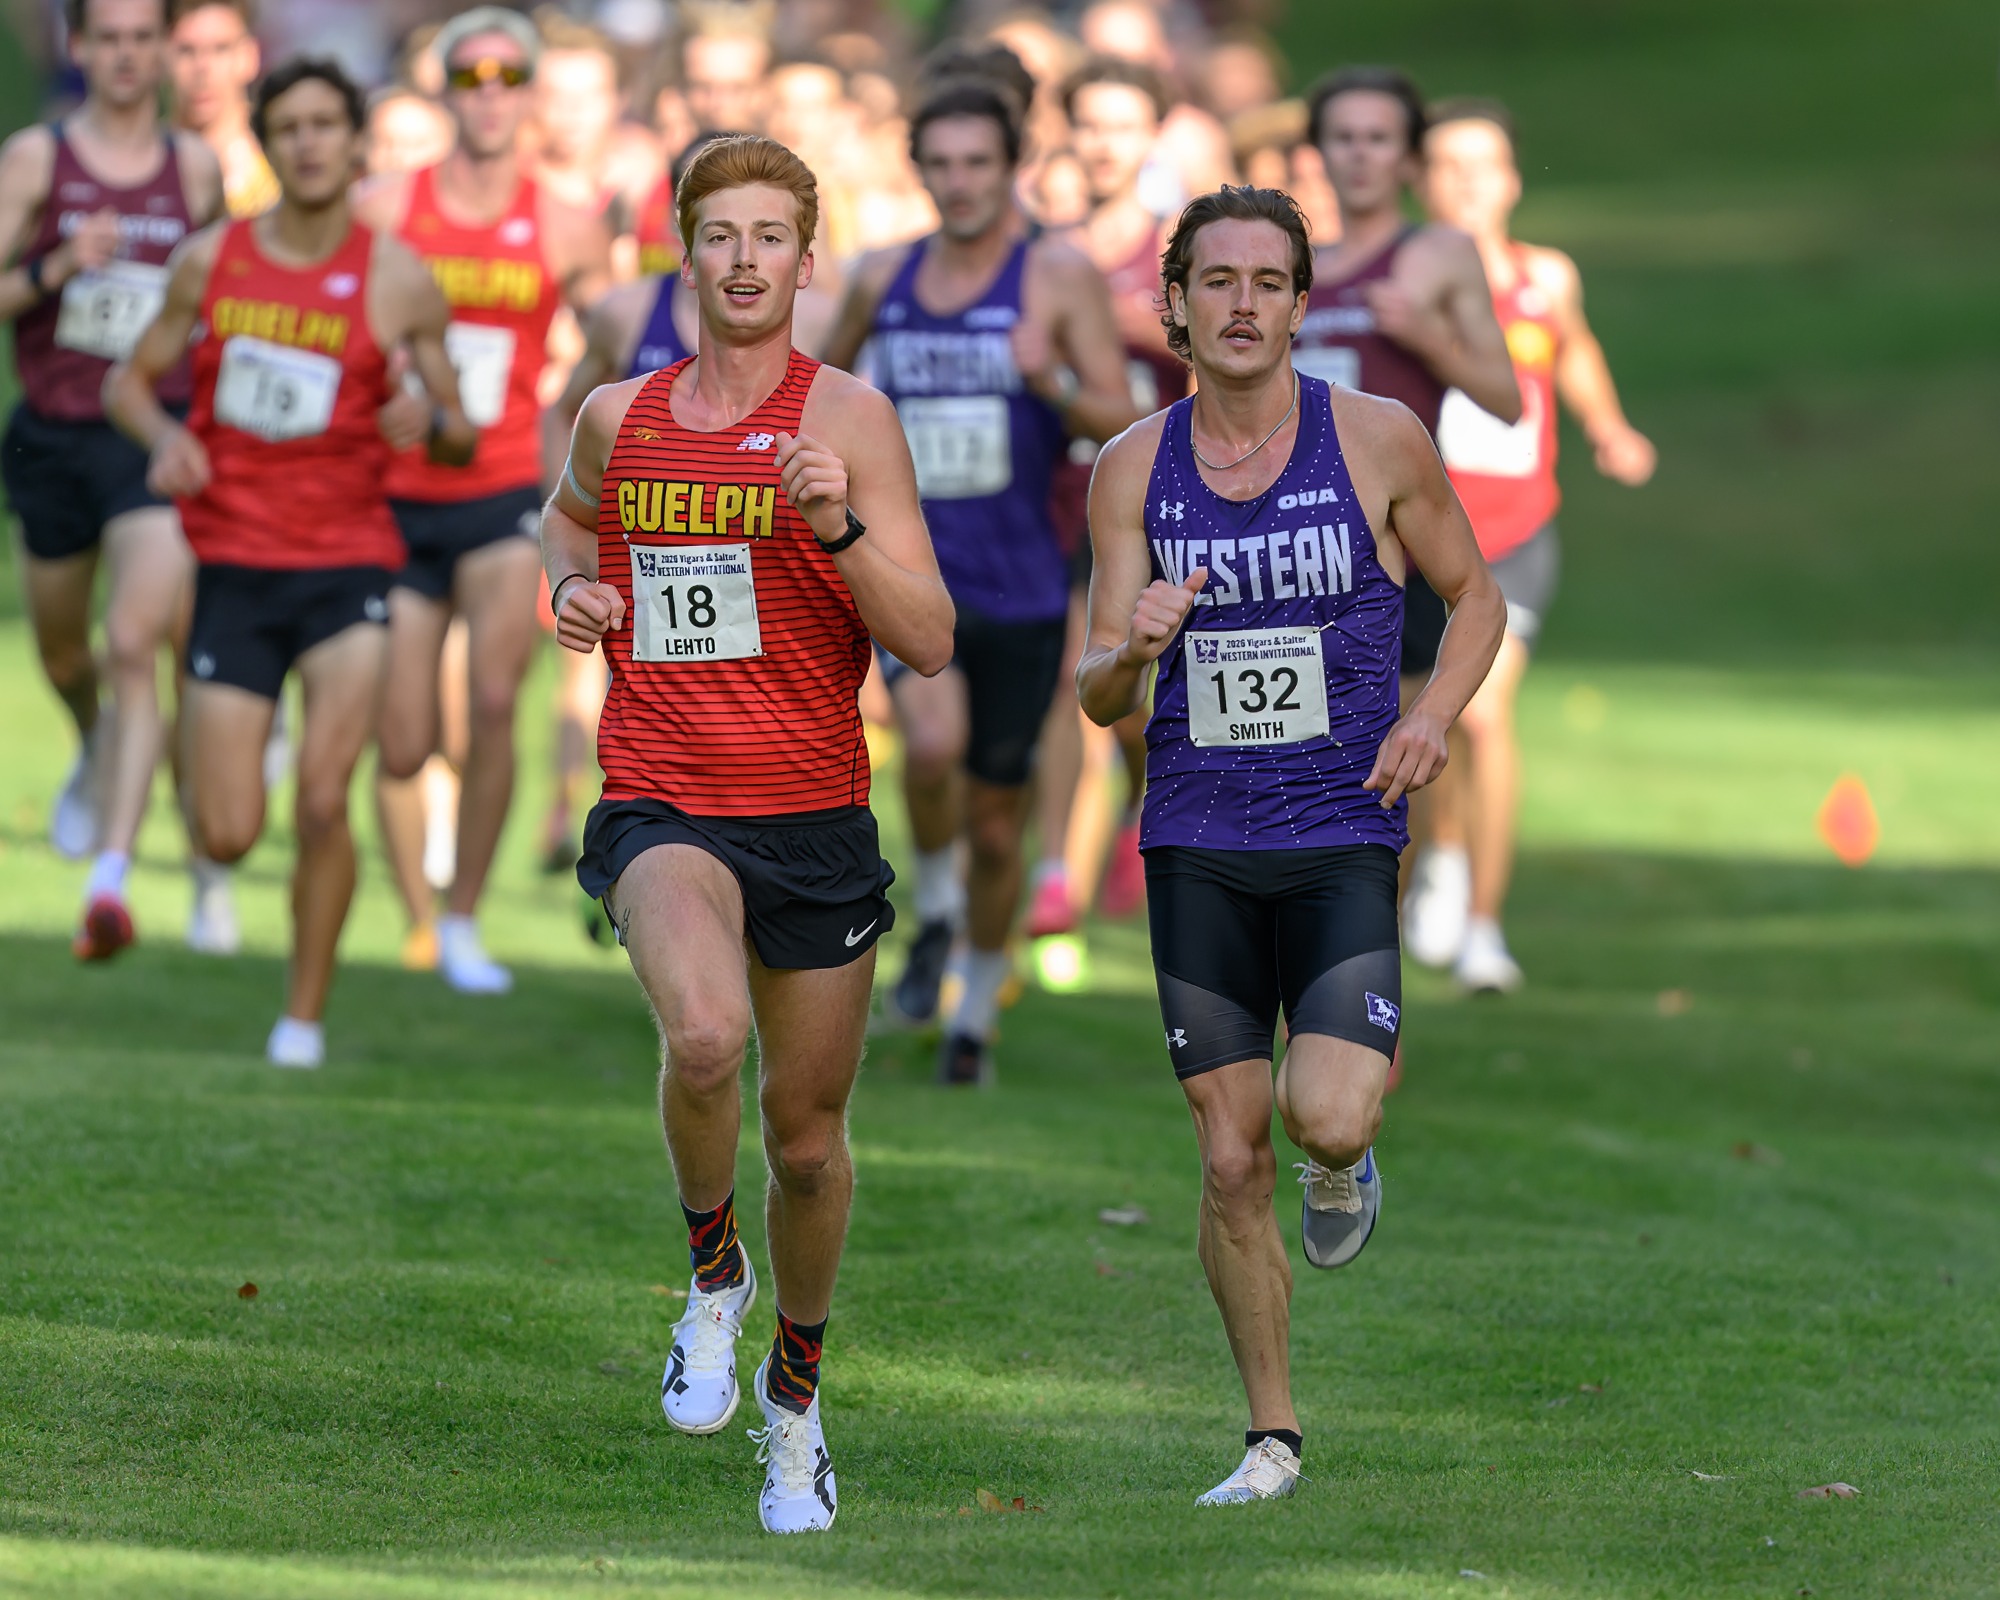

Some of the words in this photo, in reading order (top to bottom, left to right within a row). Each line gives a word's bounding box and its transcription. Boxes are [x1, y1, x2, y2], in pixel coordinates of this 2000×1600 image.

[1277, 487, 1339, 510] OUA
[617, 480, 776, 538] GUELPH
[679, 554, 704, 565] Vigars
[706, 553, 713, 562] &
[714, 553, 737, 562] Salter
[1153, 523, 1352, 607] WESTERN
[692, 564, 747, 576] INVITATIONAL
[661, 584, 717, 629] 18
[665, 637, 716, 655] LEHTO
[1226, 638, 1246, 649] 2026
[1247, 638, 1272, 648] Vigars
[1273, 636, 1282, 646] &
[1282, 635, 1307, 645] Salter
[1219, 650, 1258, 662] WESTERN
[1260, 645, 1317, 660] INVITATIONAL
[1210, 666, 1301, 714] 132
[1229, 721, 1285, 741] SMITH
